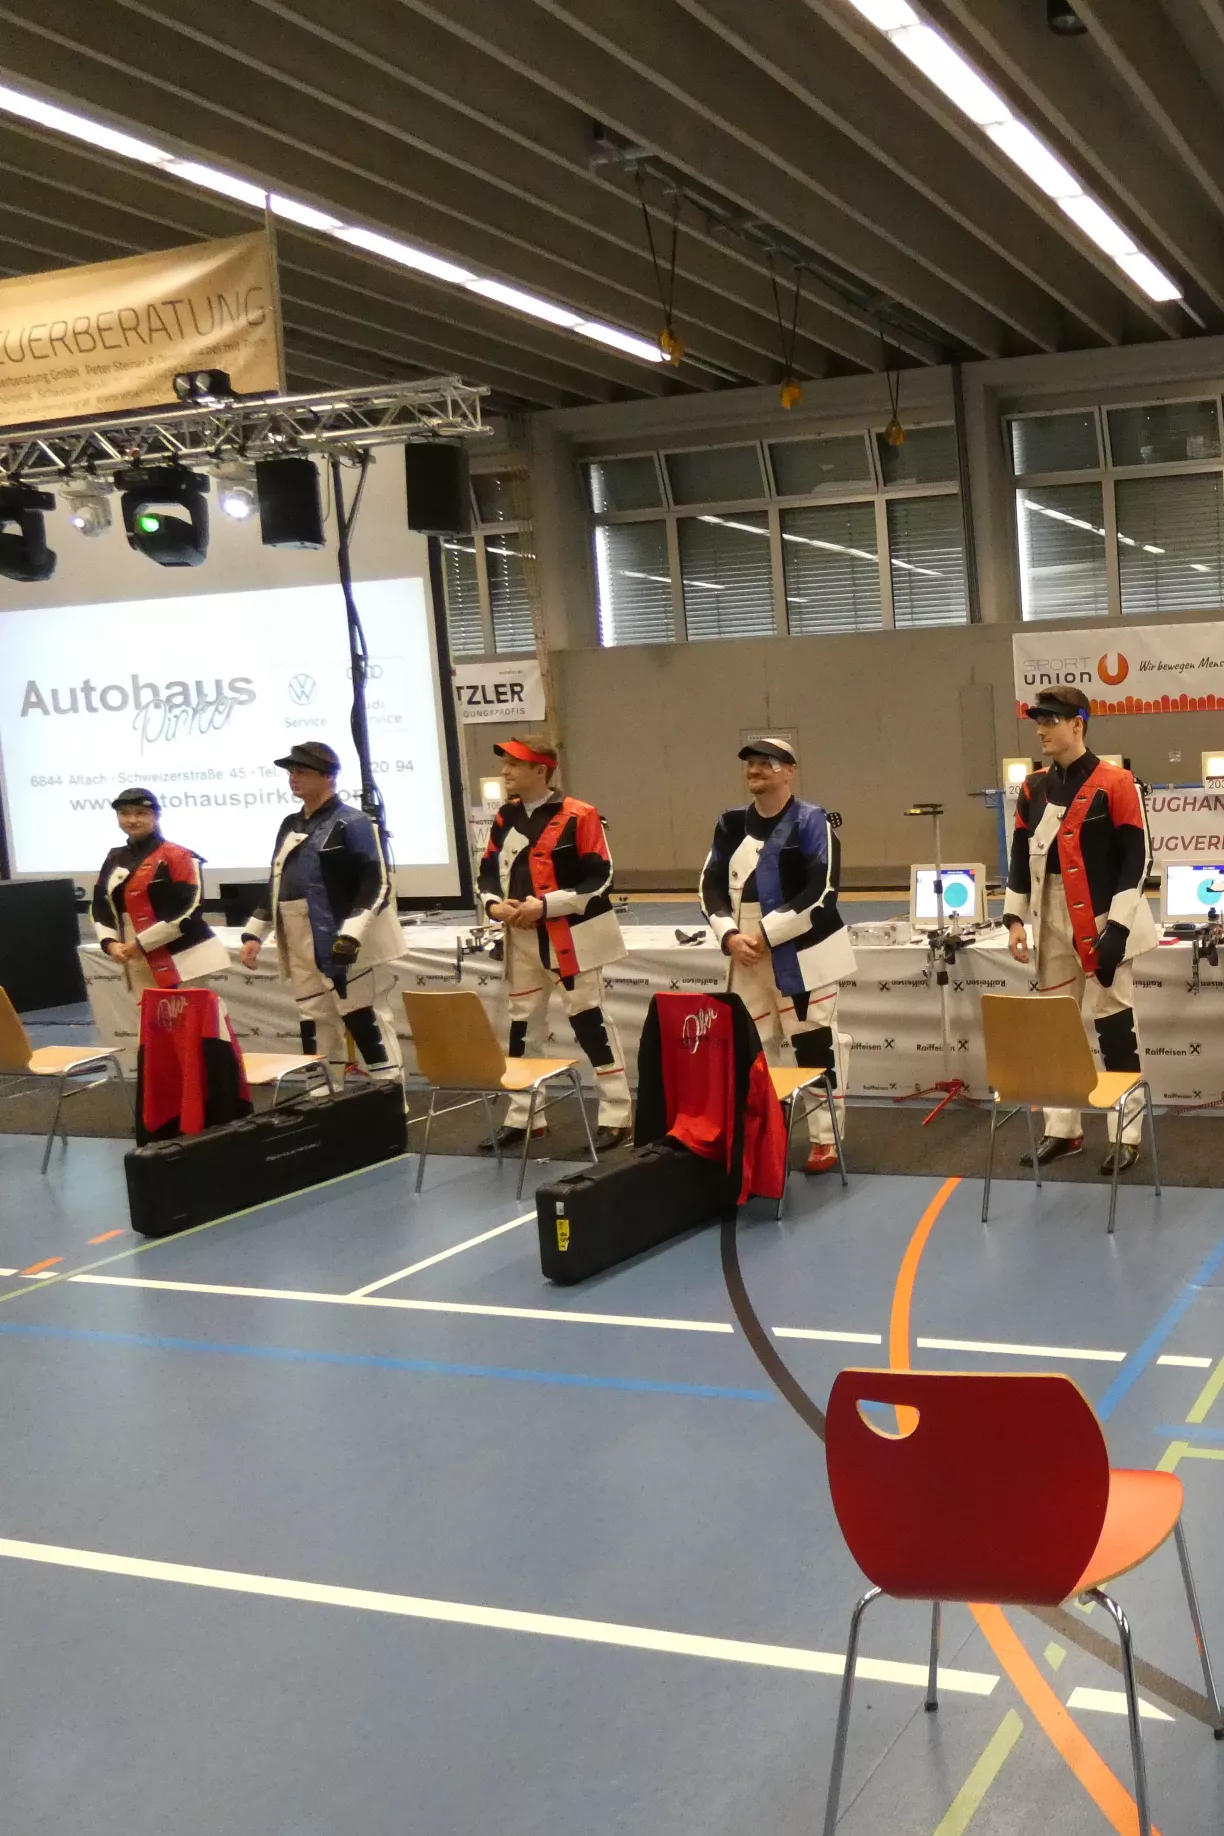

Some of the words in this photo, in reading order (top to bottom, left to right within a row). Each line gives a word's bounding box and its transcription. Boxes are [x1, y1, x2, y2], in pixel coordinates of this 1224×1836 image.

[0, 287, 266, 364] UERBERATUNG
[1023, 656, 1091, 671] SPORT
[1139, 660, 1155, 672] Wir
[1158, 661, 1195, 674] bewegen
[1024, 671, 1092, 685] union
[20, 674, 257, 718] Autohaus
[284, 716, 328, 728] Service
[369, 713, 403, 724] rvice
[31, 775, 63, 787] 6844
[69, 773, 107, 786] Altach
[118, 767, 222, 784] Schweizerstraße
[229, 767, 247, 779] 45
[395, 760, 414, 773] 94
[1009, 785, 1021, 795] 20
[965, 980, 1006, 988] Raiffeisen
[916, 1043, 955, 1052] Raiffein
[1145, 1047, 1187, 1056] Raiffeisen
